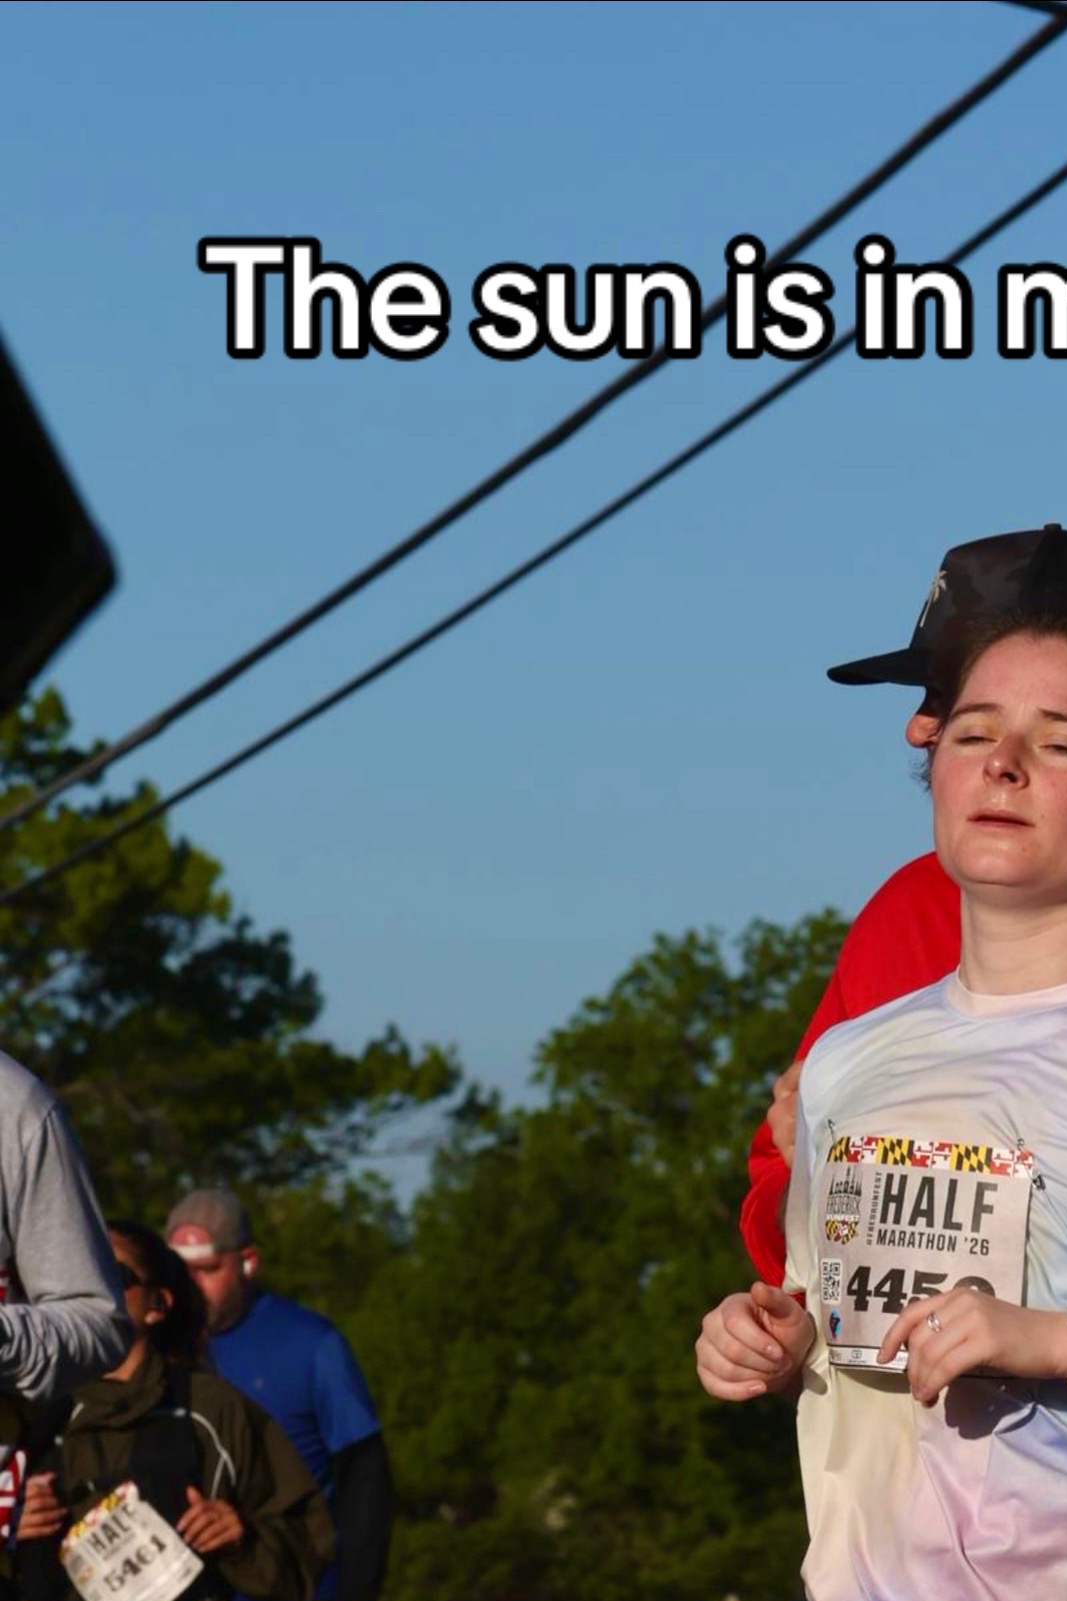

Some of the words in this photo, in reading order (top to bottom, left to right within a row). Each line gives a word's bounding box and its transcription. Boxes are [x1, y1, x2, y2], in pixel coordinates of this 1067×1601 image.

[879, 1172, 999, 1233] HALF
[876, 1228, 957, 1253] MARATHON
[964, 1238, 990, 1256] '26
